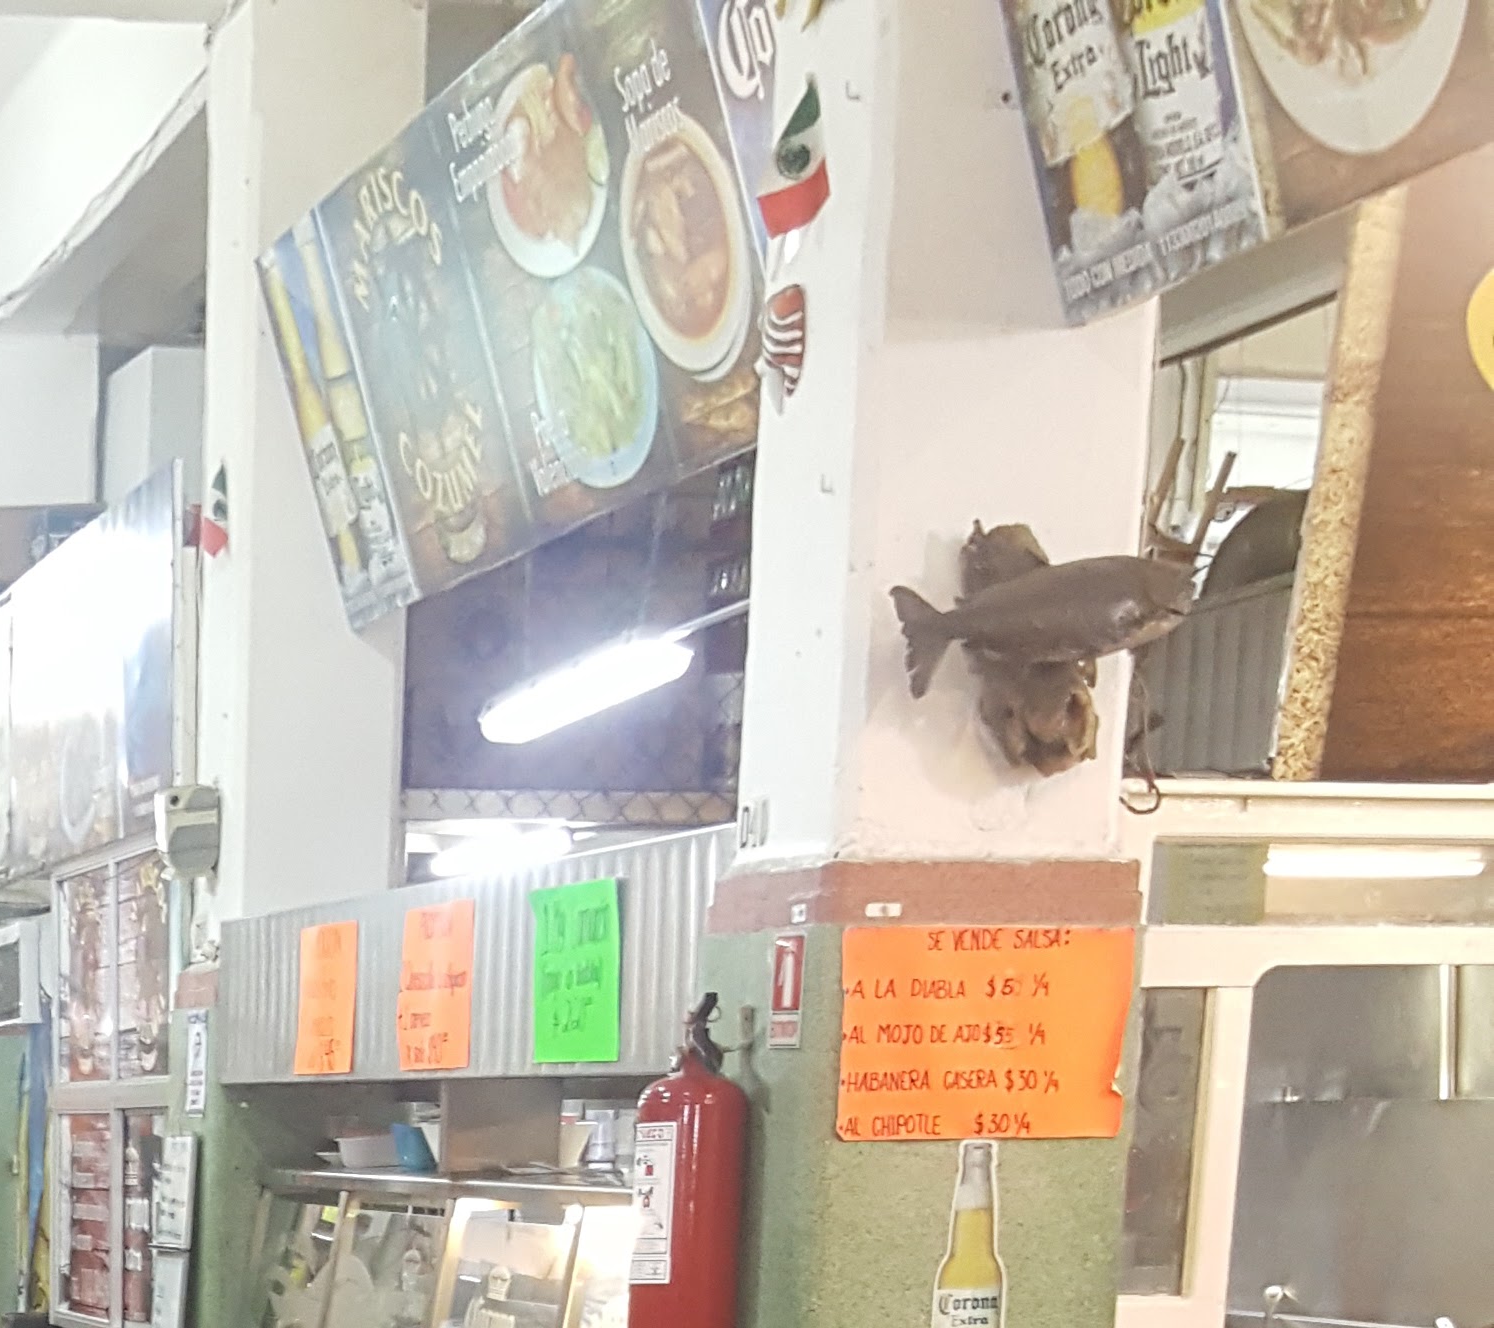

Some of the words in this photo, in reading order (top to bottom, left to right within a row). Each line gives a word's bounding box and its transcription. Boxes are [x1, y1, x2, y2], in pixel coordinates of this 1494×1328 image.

[614, 64, 652, 113] Sopa
[650, 38, 672, 88] de
[1051, 44, 1097, 92] Extra
[1133, 32, 1192, 100] Light
[352, 167, 442, 312] MARISCOS
[399, 401, 482, 514] COZUMEL
[928, 931, 944, 951] SE
[952, 929, 1003, 950] VENDE
[1013, 929, 1071, 949] SALSA:
[874, 979, 896, 999] LA
[911, 978, 965, 999] DIABLA
[877, 1024, 923, 1045] MOJO
[930, 1024, 948, 1044] DE
[846, 1070, 930, 1093] HABANERA
[943, 1070, 998, 1091] CASERA
[872, 1114, 942, 1136] CHIPOTLE
[938, 1293, 998, 1315] Corona
[951, 1315, 989, 1327] Extra
